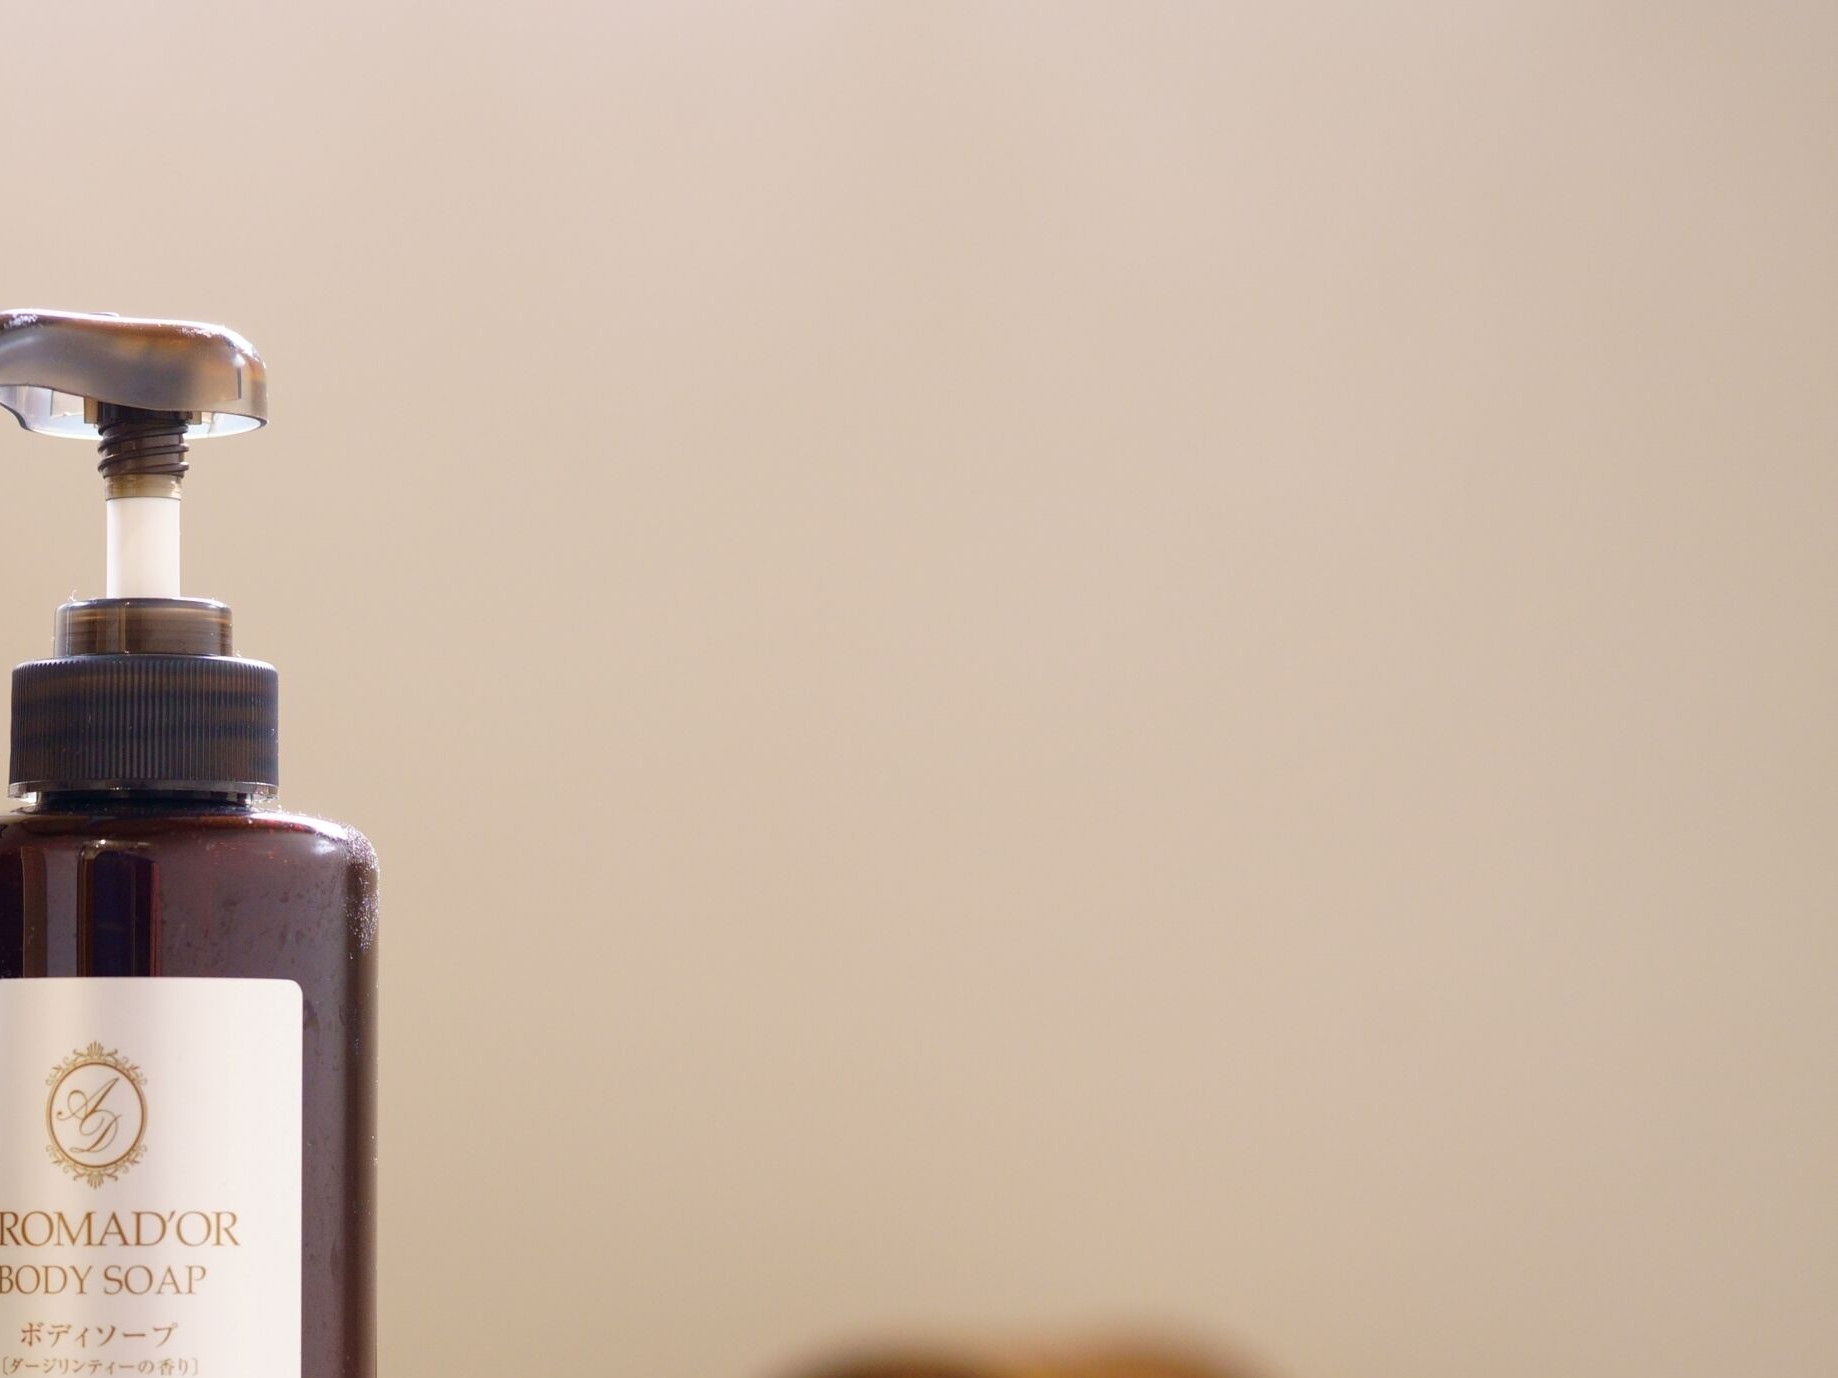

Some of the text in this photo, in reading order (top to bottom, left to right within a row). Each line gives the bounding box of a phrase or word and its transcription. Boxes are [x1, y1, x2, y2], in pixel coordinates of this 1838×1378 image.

[103, 1265, 207, 1295] SOAP
[20, 1322, 179, 1348] ボディソープ
